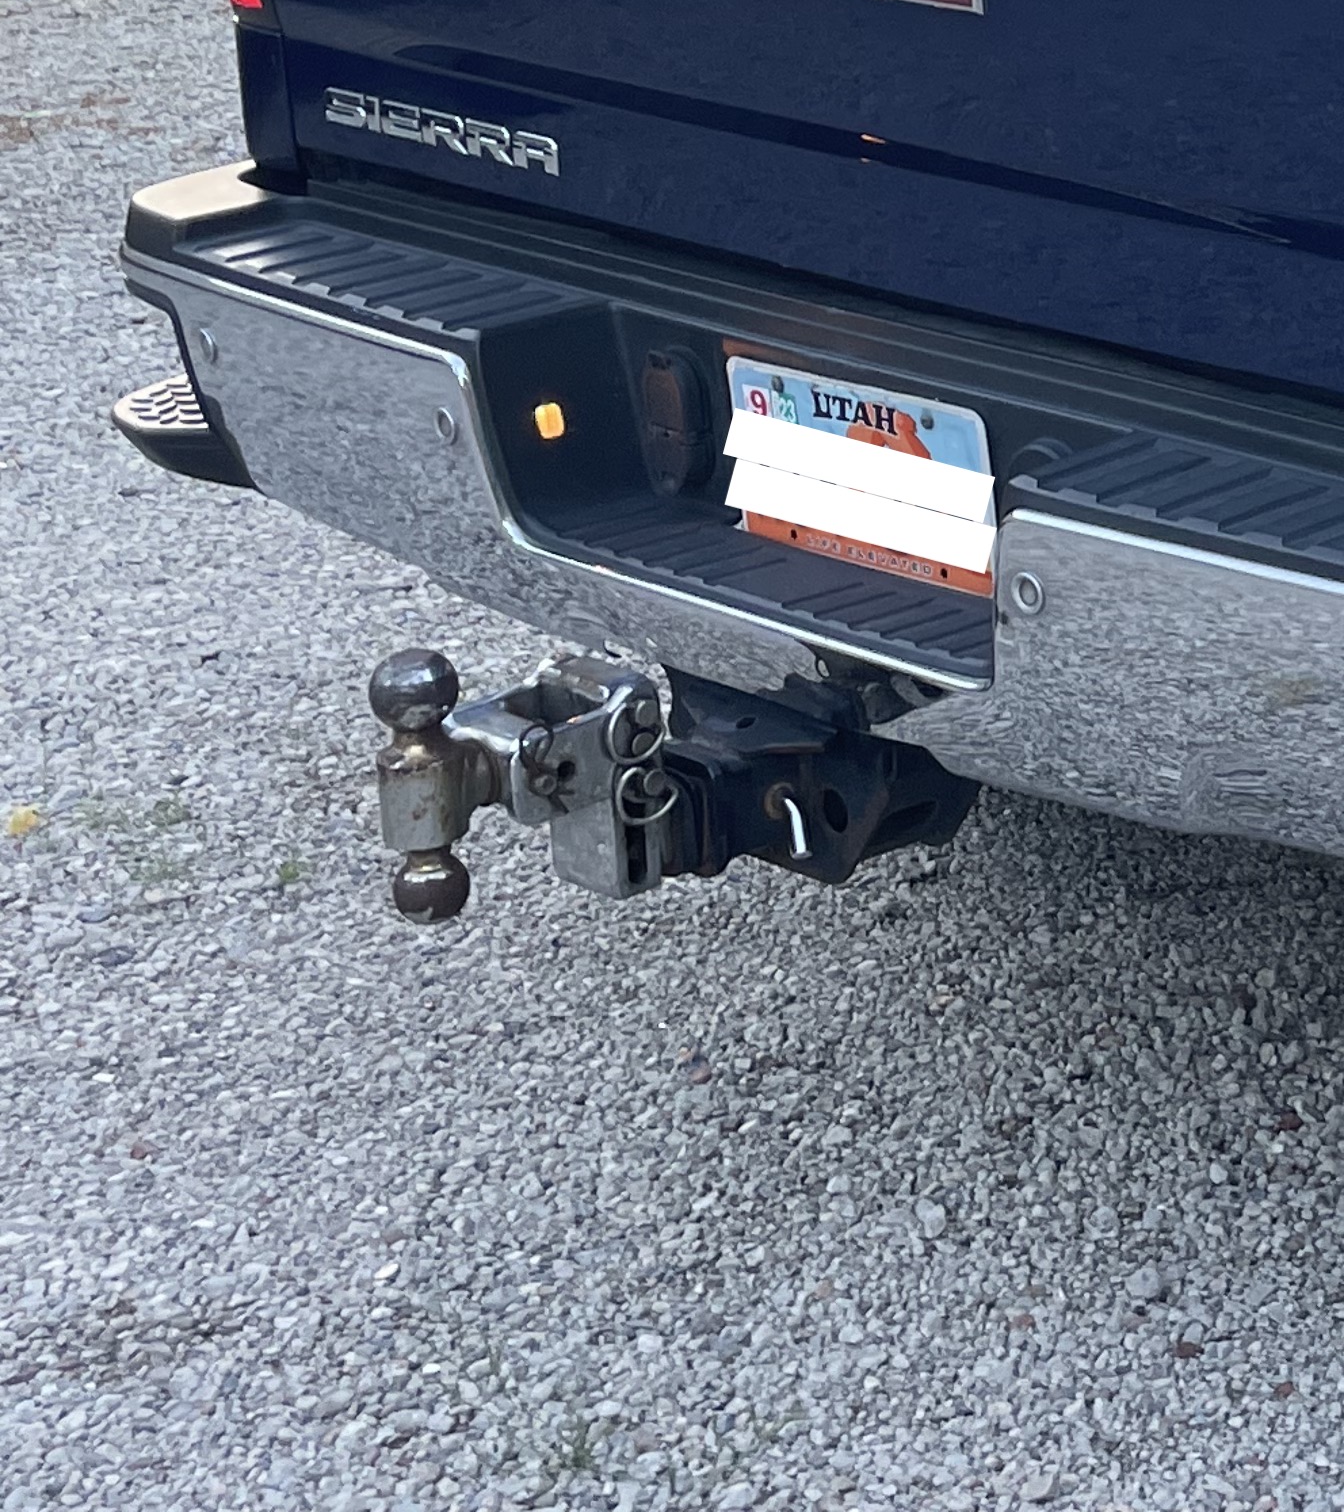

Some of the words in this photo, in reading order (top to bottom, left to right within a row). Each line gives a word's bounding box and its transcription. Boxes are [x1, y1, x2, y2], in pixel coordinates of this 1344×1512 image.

[324, 85, 561, 177] SIERRA
[750, 389, 768, 416] 9
[810, 386, 899, 437] UTAH
[805, 533, 842, 554] LIFE
[846, 544, 934, 576] ELEVATED
